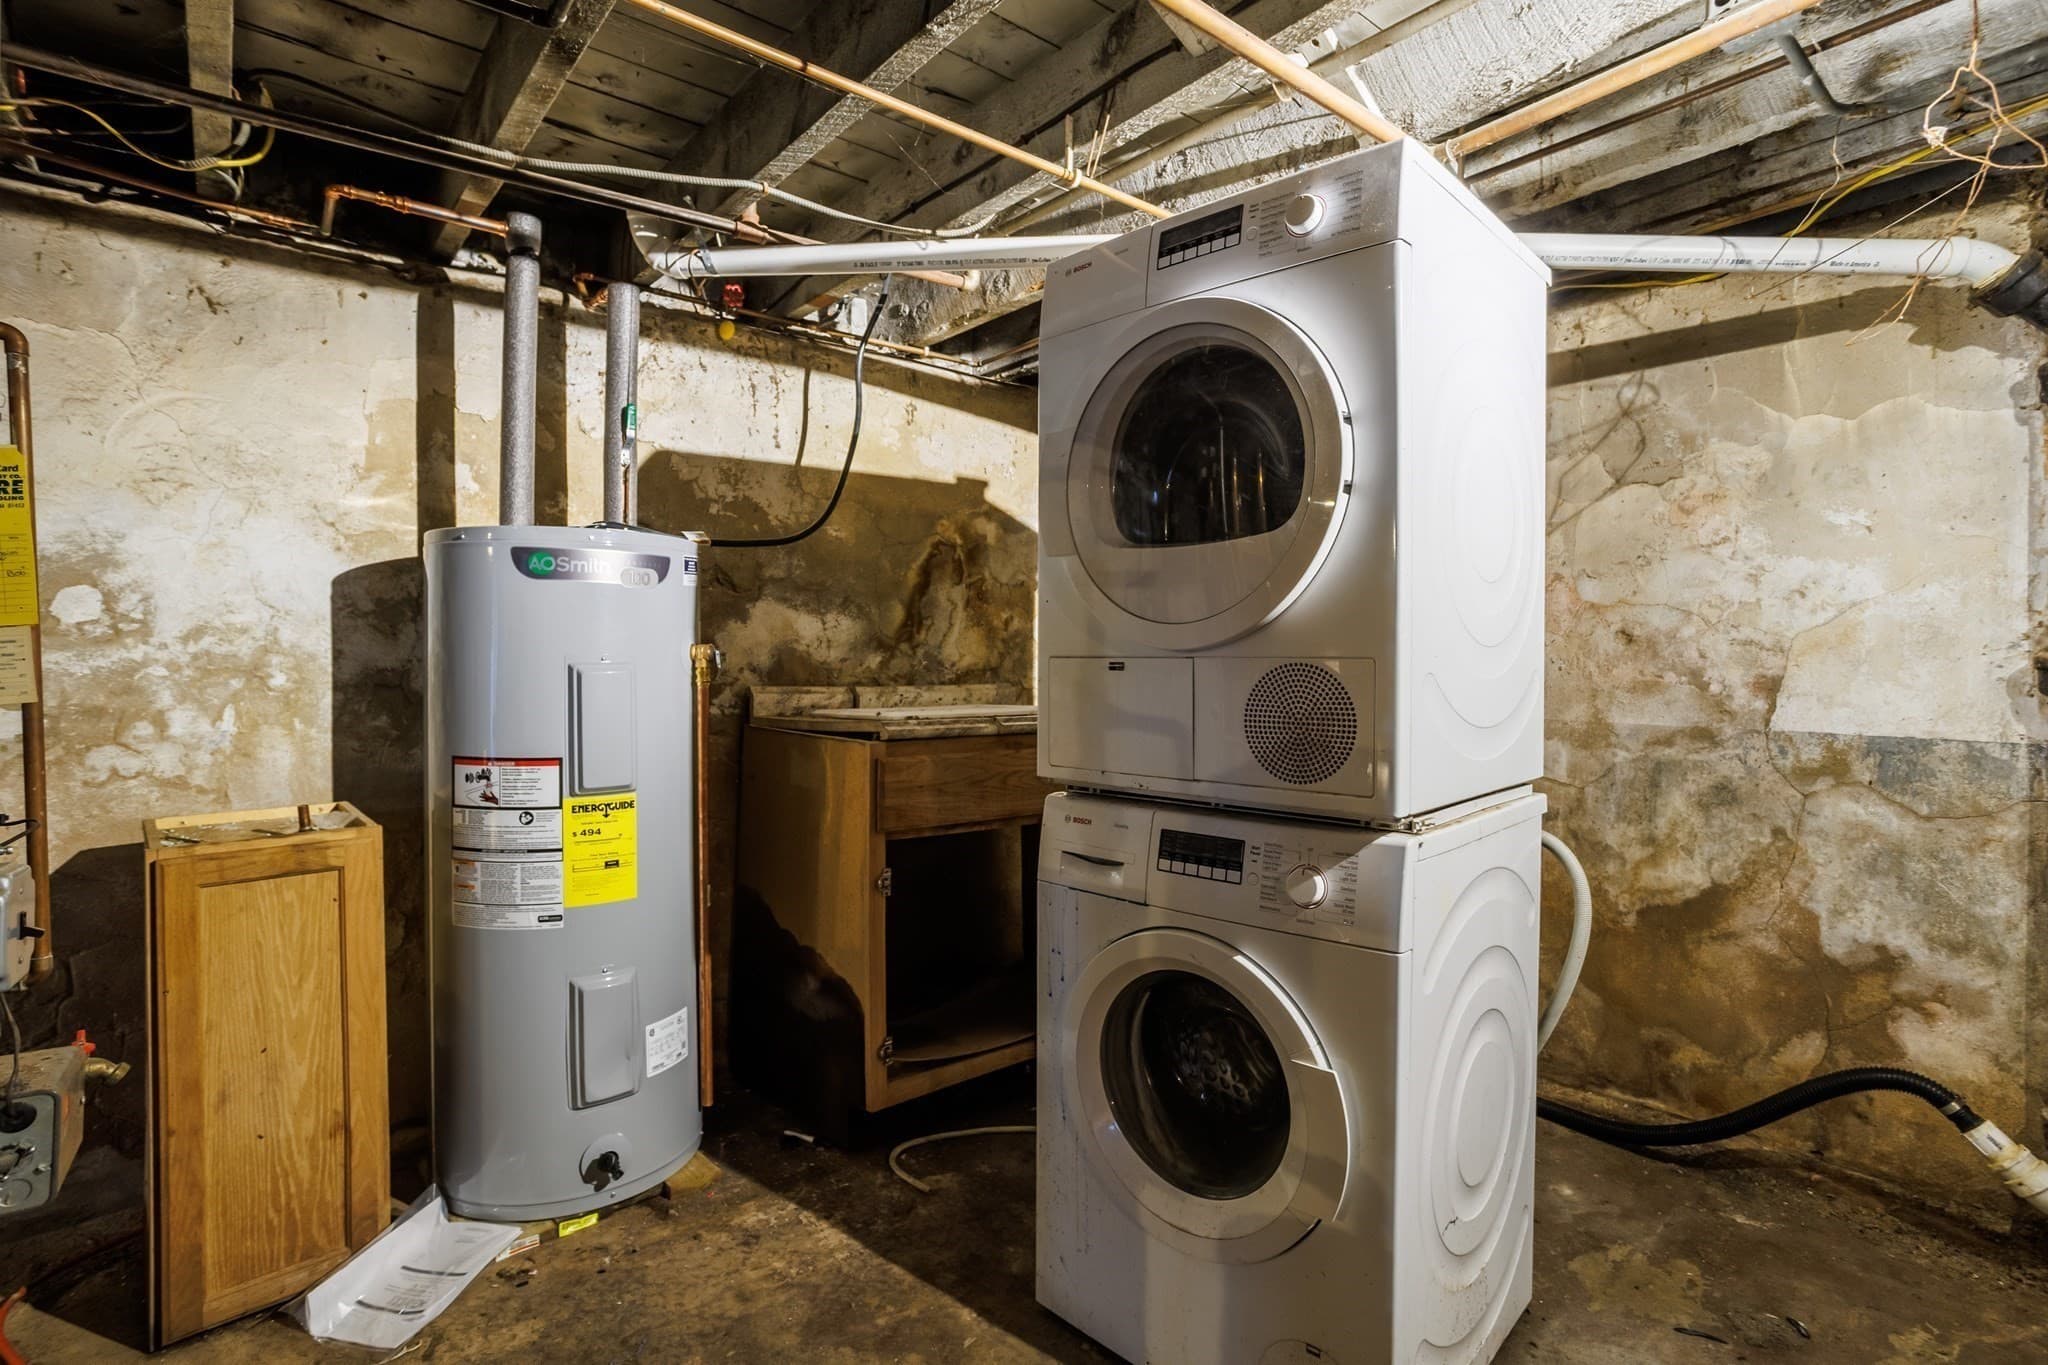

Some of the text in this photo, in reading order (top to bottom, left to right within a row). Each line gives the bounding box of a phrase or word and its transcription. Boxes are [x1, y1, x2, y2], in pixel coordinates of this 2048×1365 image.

[1073, 262, 1093, 273] BOSCH
[571, 800, 635, 815] ENERGYGUIDE
[1073, 817, 1092, 825] BOSCH
[580, 828, 601, 837] 494
